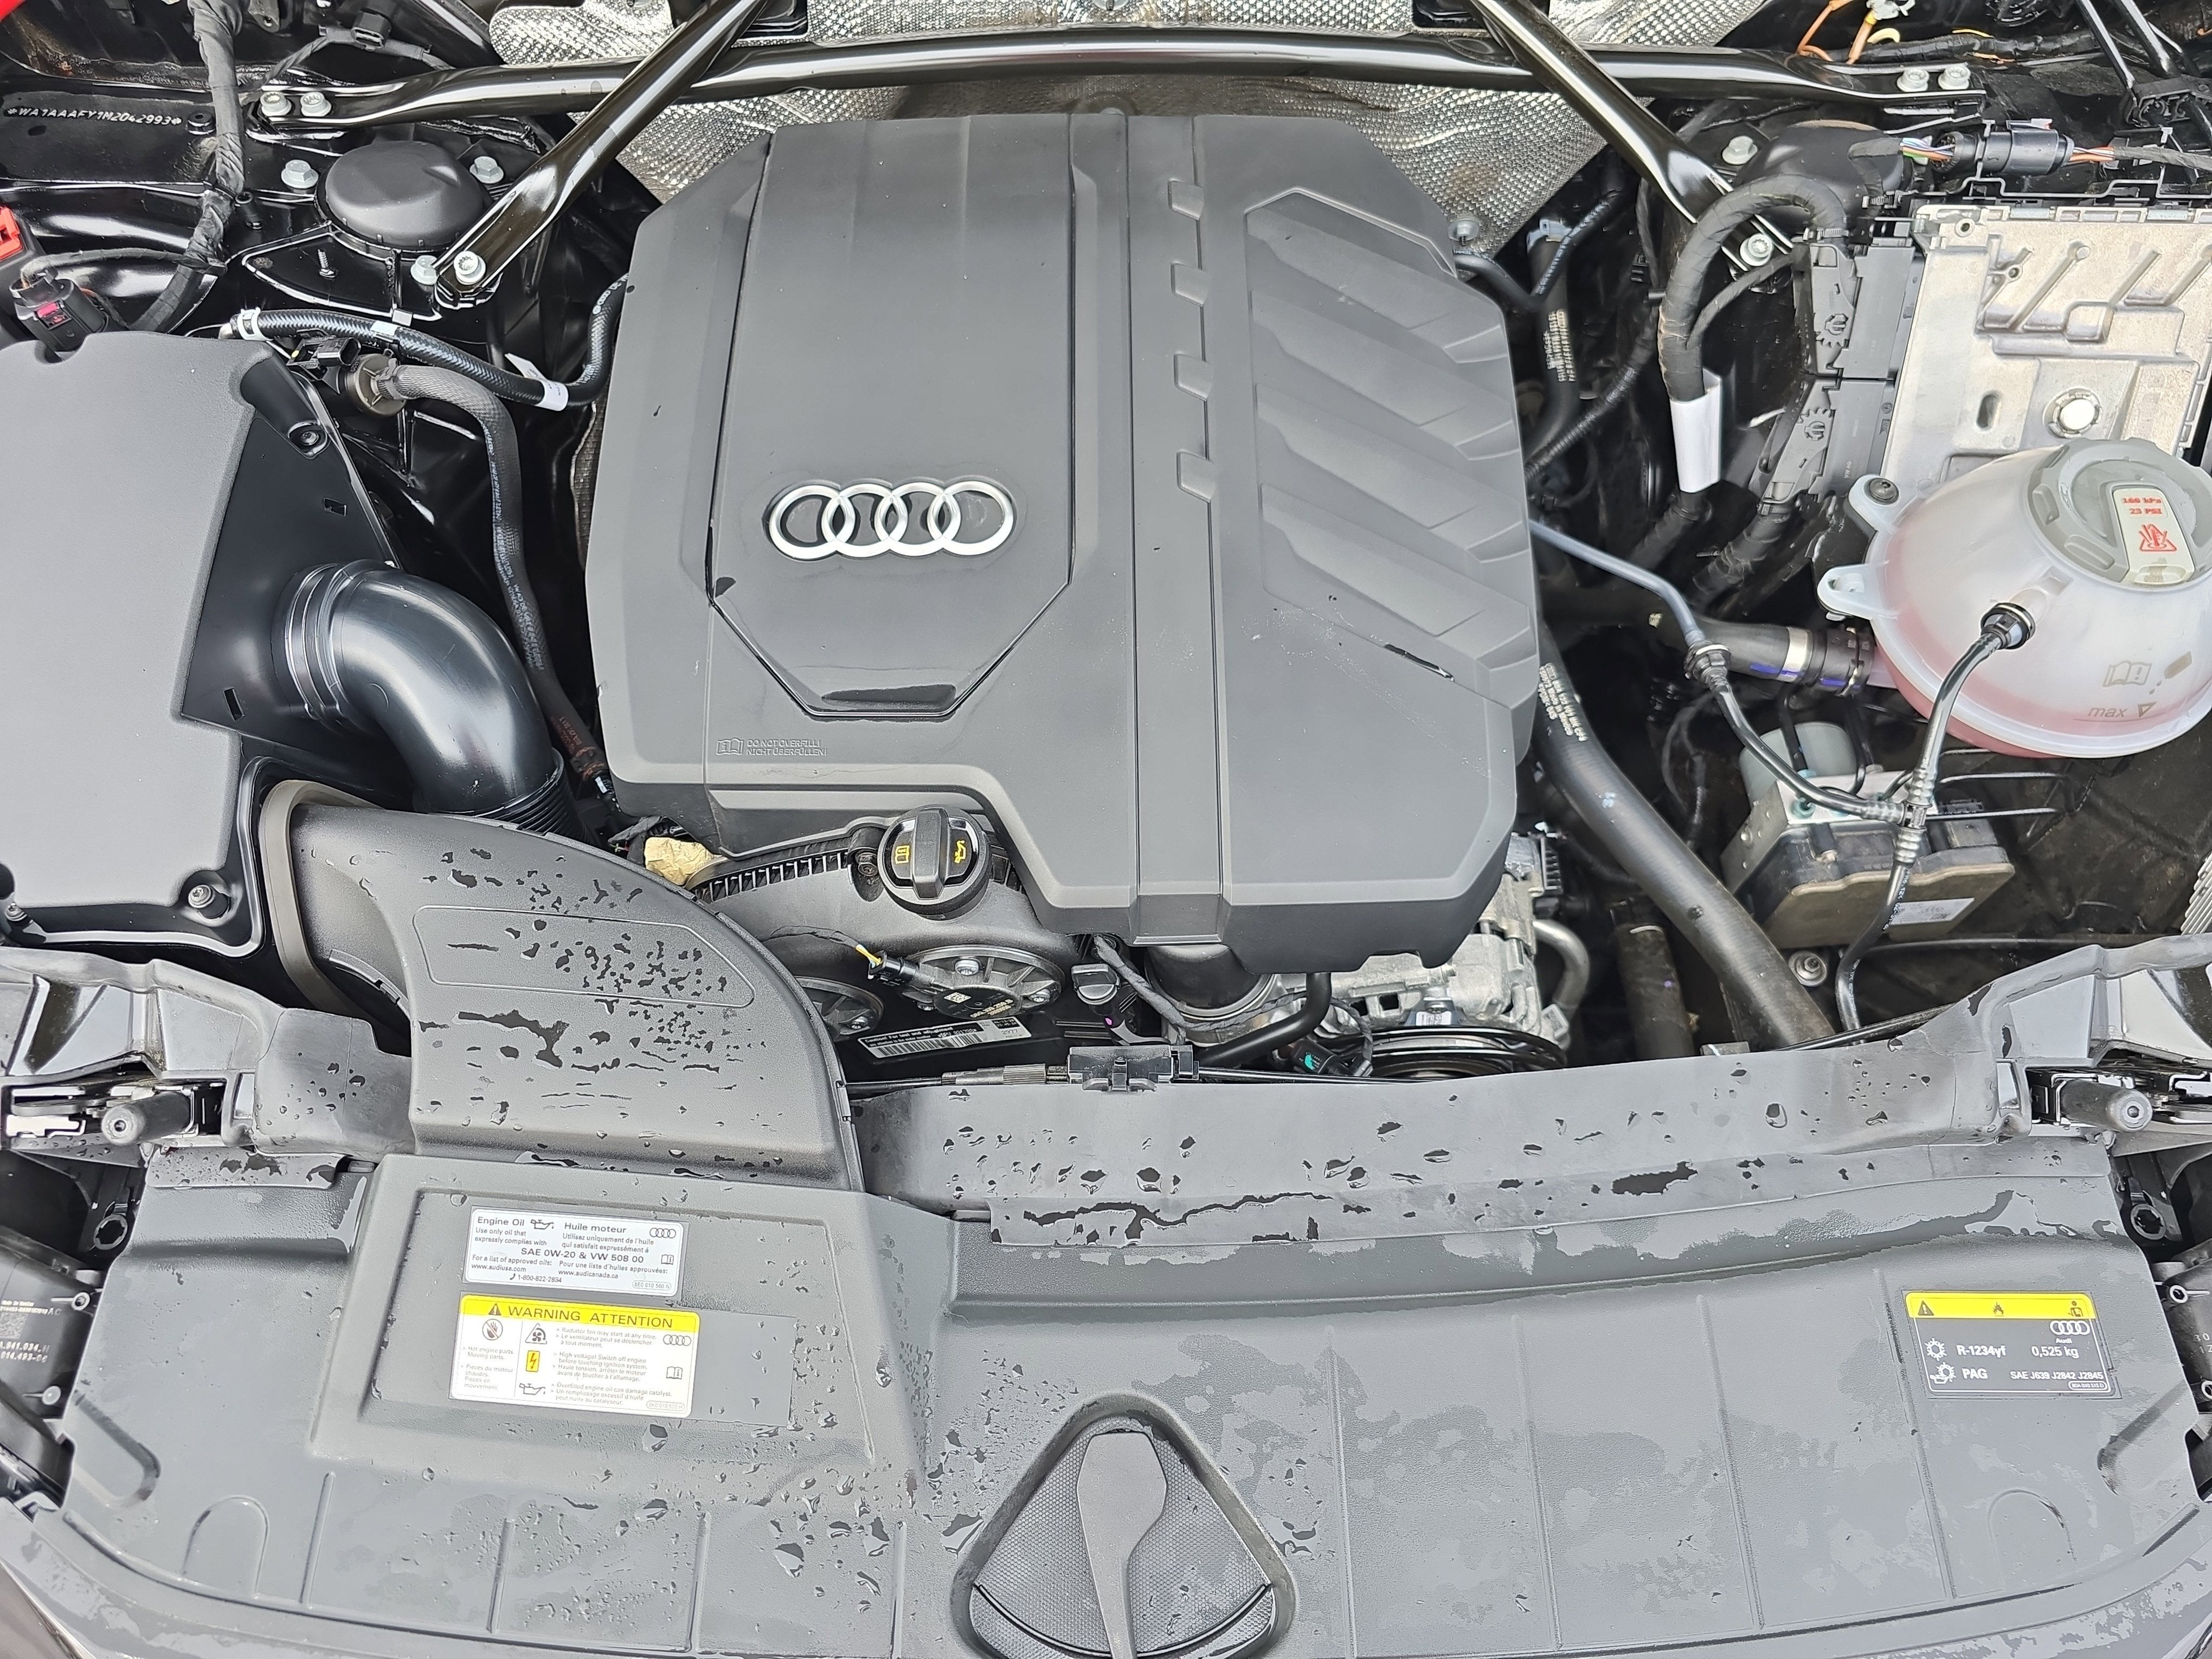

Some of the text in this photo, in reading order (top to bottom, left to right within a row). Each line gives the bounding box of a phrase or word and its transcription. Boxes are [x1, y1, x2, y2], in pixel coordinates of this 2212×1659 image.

[2087, 707, 2127, 717] max
[478, 1217, 509, 1226] Engine
[564, 1223, 588, 1231] Huile
[587, 1235, 624, 1243] uniquement
[544, 1249, 575, 1258] 0W-20
[590, 1252, 608, 1261] VW
[472, 1263, 526, 1272] www.audiusa.com
[630, 1266, 668, 1275] approuvées:
[558, 1270, 618, 1279] www.audicanada.ca
[508, 1306, 672, 1328] WARNING ATTENTION
[1956, 1345, 2079, 1359] R-1234yf 0,525 kg
[1962, 1368, 2104, 1380] PAG SAE J639 J2842 J2845
[565, 1390, 600, 1398] remplissage
